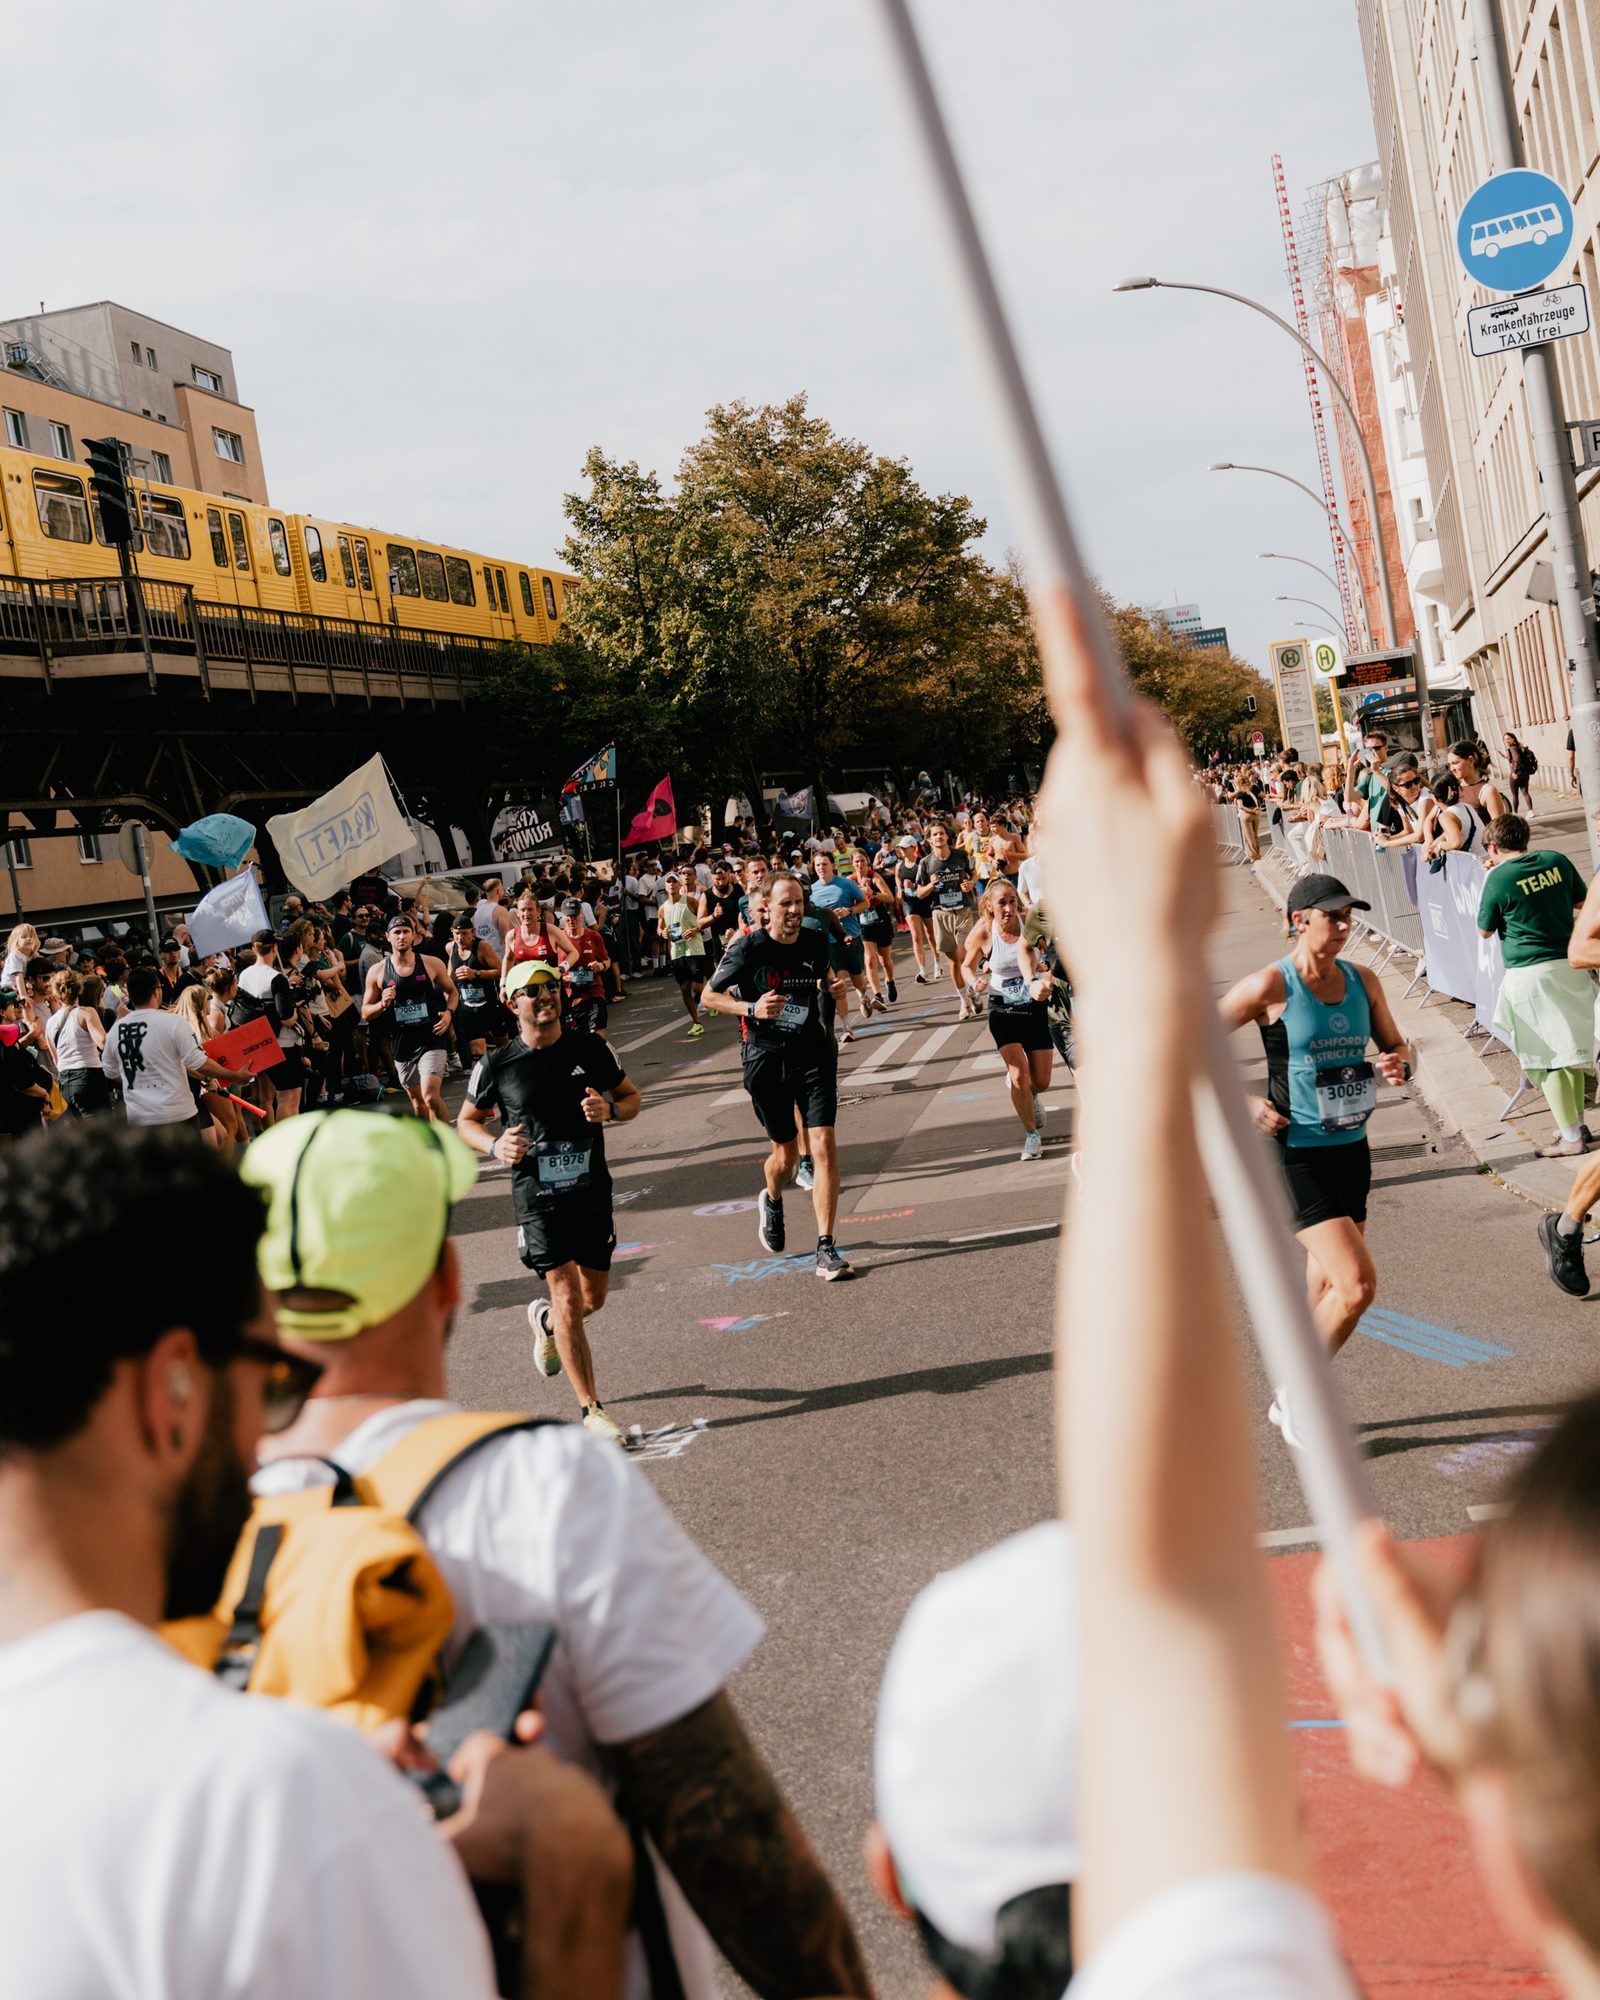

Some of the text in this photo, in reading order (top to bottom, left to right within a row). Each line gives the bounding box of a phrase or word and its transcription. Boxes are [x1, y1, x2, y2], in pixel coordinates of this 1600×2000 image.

[1480, 306, 1575, 336] Krankenfahrzeuge
[1499, 322, 1561, 347] TAXI frei
[388, 575, 397, 592] F
[1285, 652, 1296, 664] H
[1320, 650, 1331, 666] H
[1516, 867, 1562, 895] TEAM
[119, 1022, 148, 1040] REC
[1309, 1036, 1360, 1050] ASHFORD
[1303, 1049, 1347, 1065] DISTRICT
[548, 1153, 585, 1168] 81978
